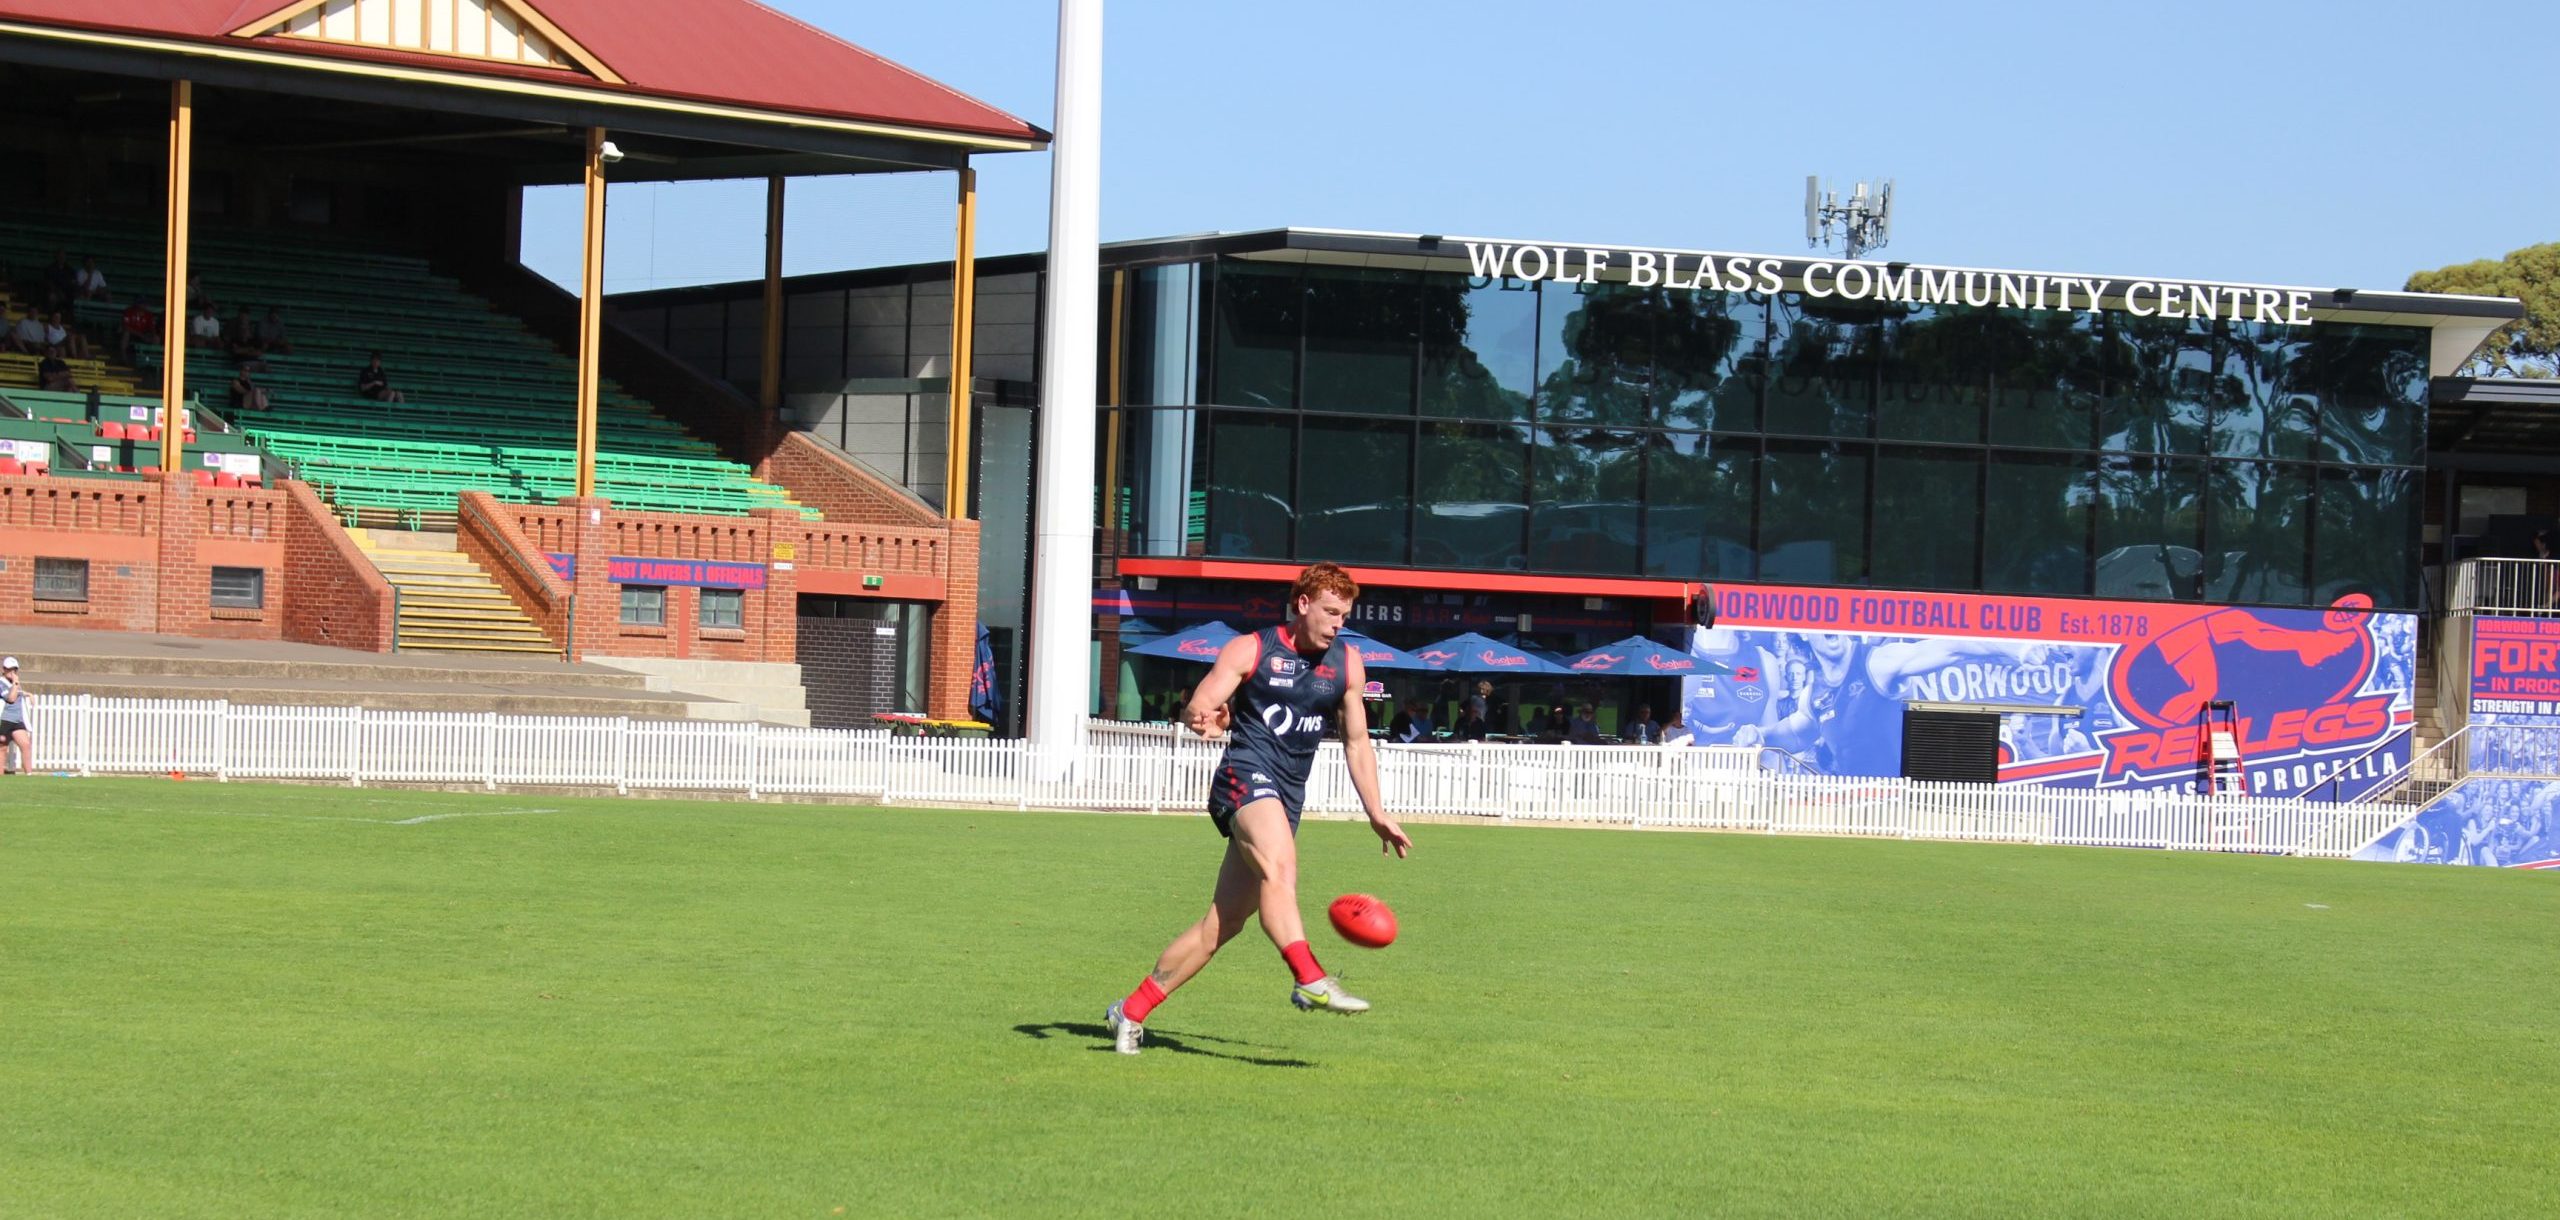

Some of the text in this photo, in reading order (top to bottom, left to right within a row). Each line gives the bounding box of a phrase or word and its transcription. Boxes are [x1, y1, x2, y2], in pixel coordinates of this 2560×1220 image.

[1464, 242, 2313, 326] WOLF BLASS COMMUNITY CENTRE
[608, 561, 637, 579] PAST
[640, 563, 692, 582] PLAYERS
[706, 566, 764, 585] OFFICIALS
[1850, 597, 1970, 629] FOOTBALL
[1979, 603, 2042, 632] CLUB
[2477, 619, 2537, 633] NORWOOD
[2475, 640, 2560, 677] FOR
[2492, 677, 2510, 692] IN
[2473, 699, 2535, 714] STRENGTH
[2538, 701, 2552, 714] IN
[2108, 698, 2388, 775] RELEGS
[2253, 752, 2398, 794] PROCELLA
